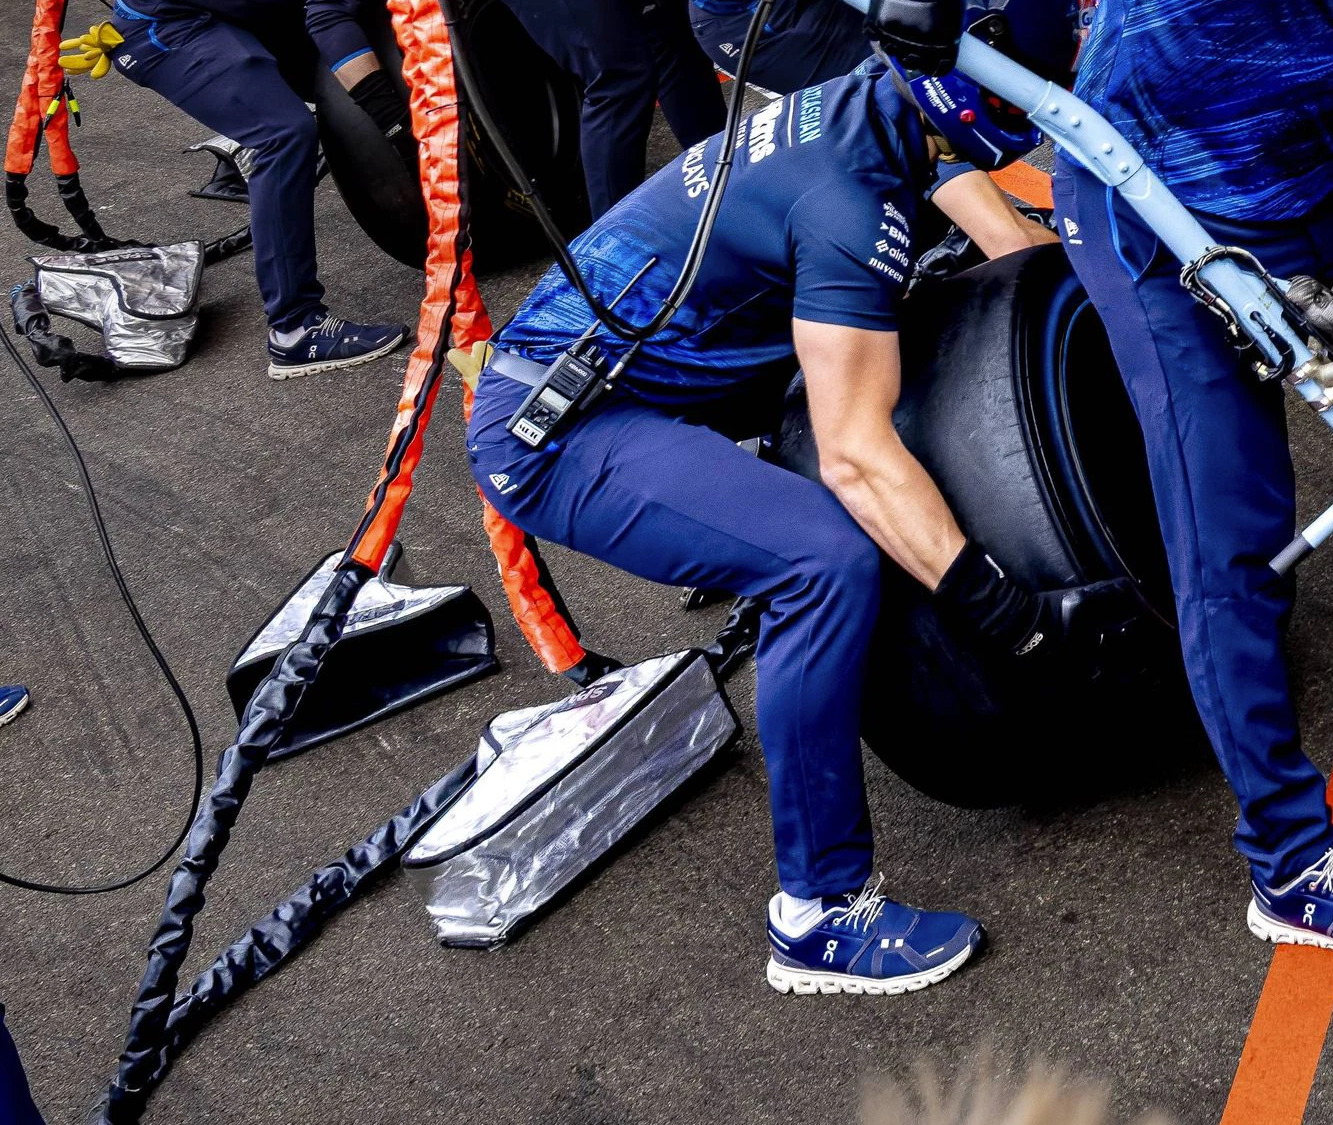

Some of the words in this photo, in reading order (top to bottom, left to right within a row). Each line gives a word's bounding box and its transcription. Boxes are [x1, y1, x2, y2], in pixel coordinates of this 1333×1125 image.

[922, 79, 948, 114] Williams
[933, 78, 957, 109] ATLASSIAN
[888, 226, 911, 248] BNY
[888, 246, 909, 267] airia
[869, 257, 904, 284] nuveen
